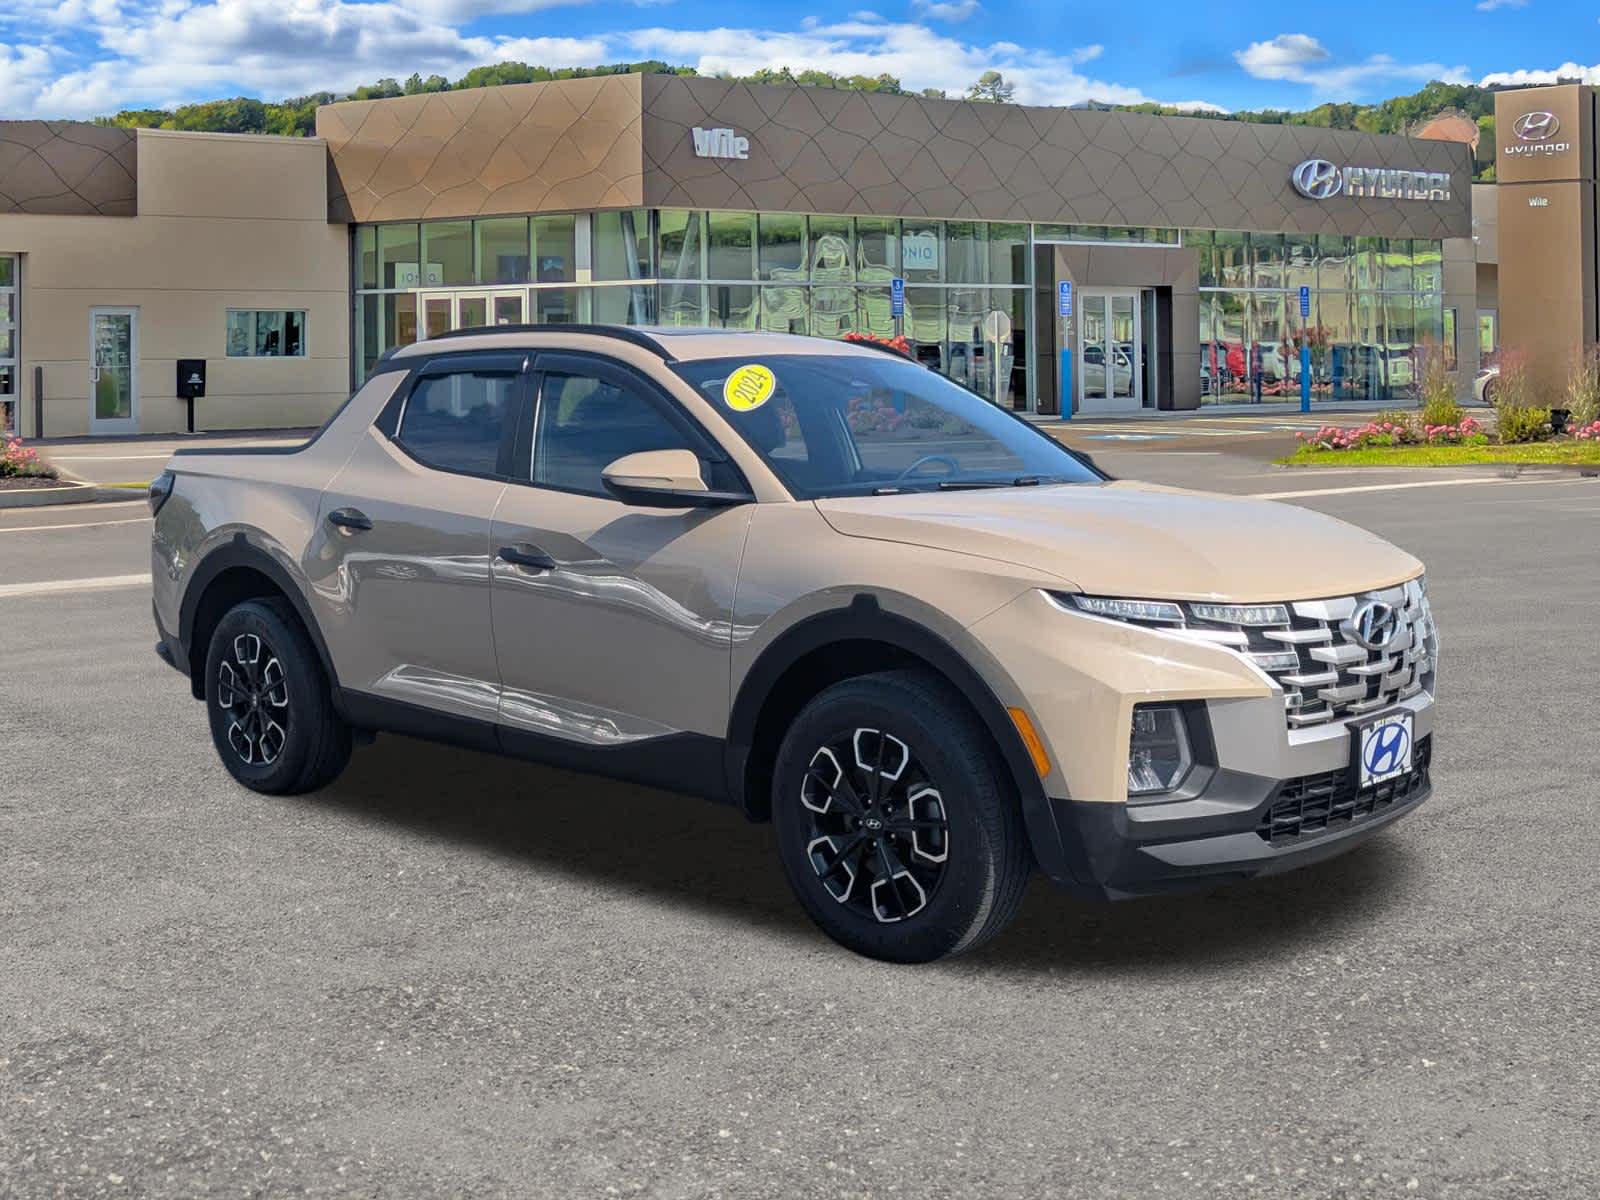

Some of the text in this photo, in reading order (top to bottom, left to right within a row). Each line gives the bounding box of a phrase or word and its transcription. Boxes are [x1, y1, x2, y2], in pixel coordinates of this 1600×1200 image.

[692, 127, 750, 160] Wile
[1342, 166, 1450, 201] HYUNDAI
[732, 368, 768, 404] 2024
